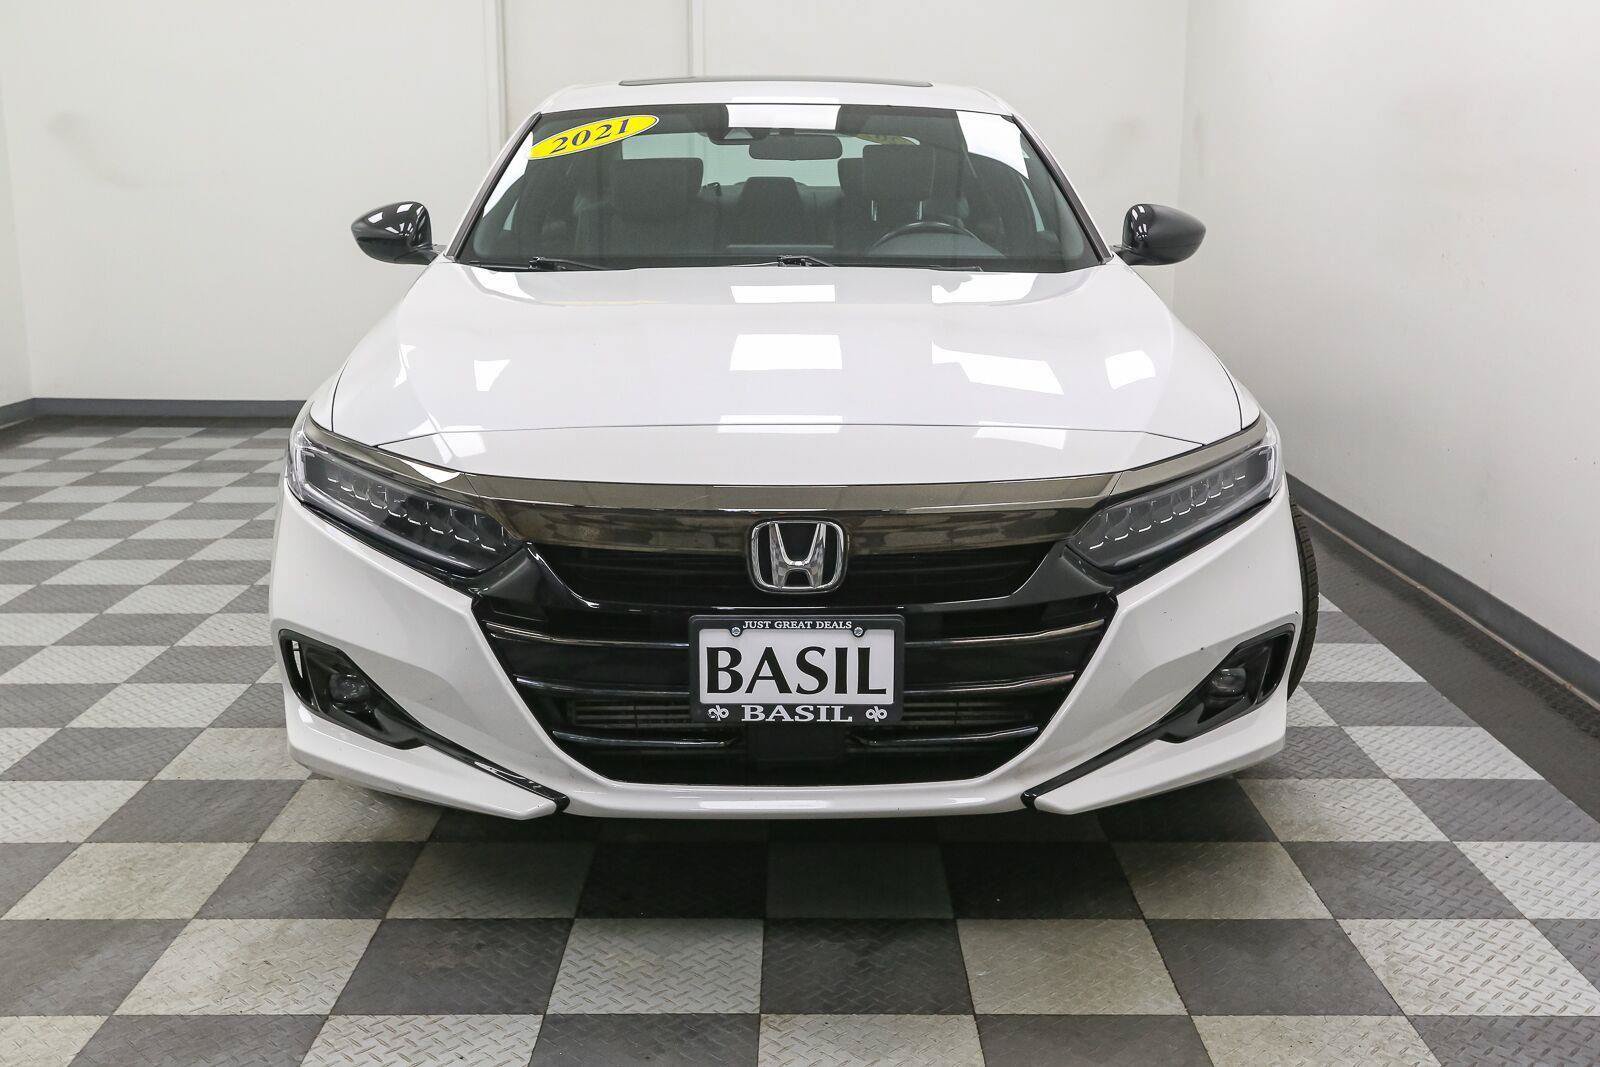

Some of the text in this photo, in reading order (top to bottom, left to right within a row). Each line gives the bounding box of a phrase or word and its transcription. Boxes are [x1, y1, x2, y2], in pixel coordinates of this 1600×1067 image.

[549, 118, 629, 154] 2021
[742, 620, 852, 629] JUST GREAT DEALS
[706, 646, 887, 695] BASIL
[741, 705, 853, 722] BASIL
